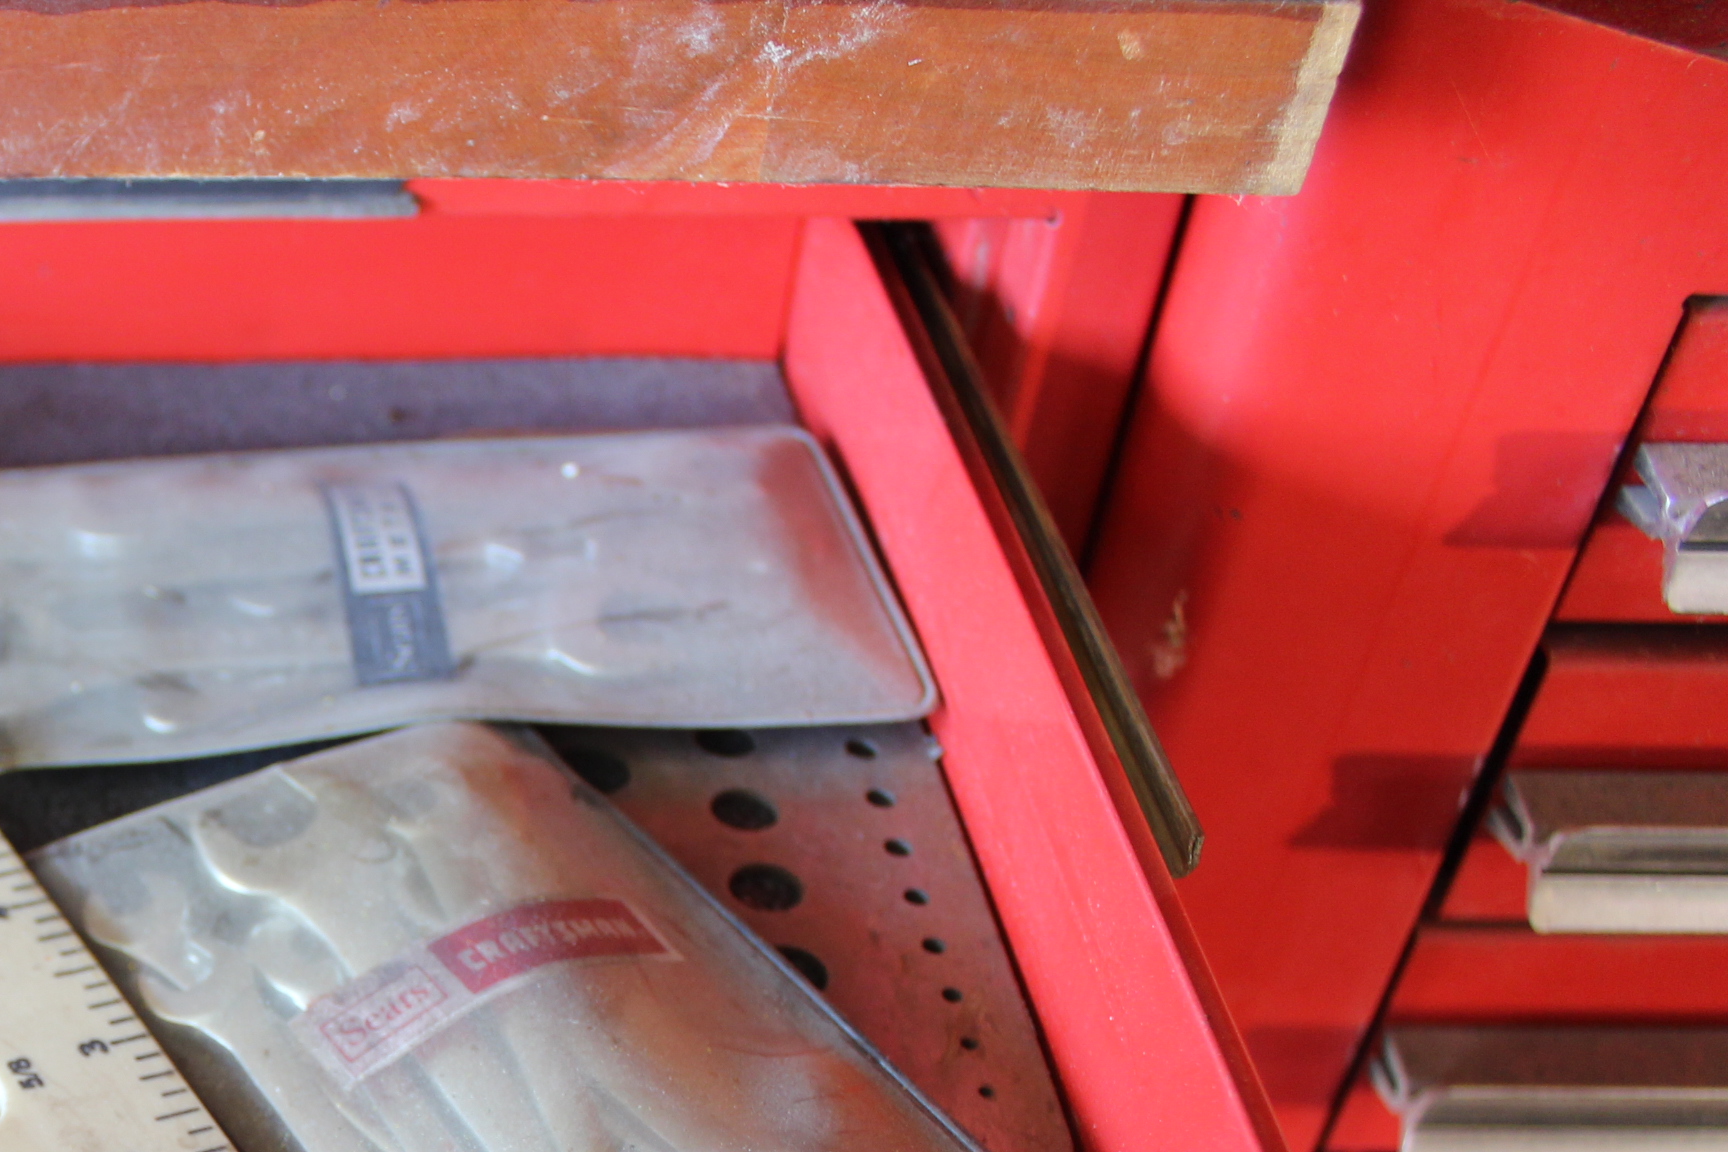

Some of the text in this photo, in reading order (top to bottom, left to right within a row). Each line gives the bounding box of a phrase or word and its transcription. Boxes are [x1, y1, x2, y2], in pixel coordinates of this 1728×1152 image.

[456, 916, 638, 973] CRAFTSMAN
[338, 982, 431, 1045] Sears
[78, 1039, 109, 1057] 3
[7, 1058, 44, 1089] 5/8
